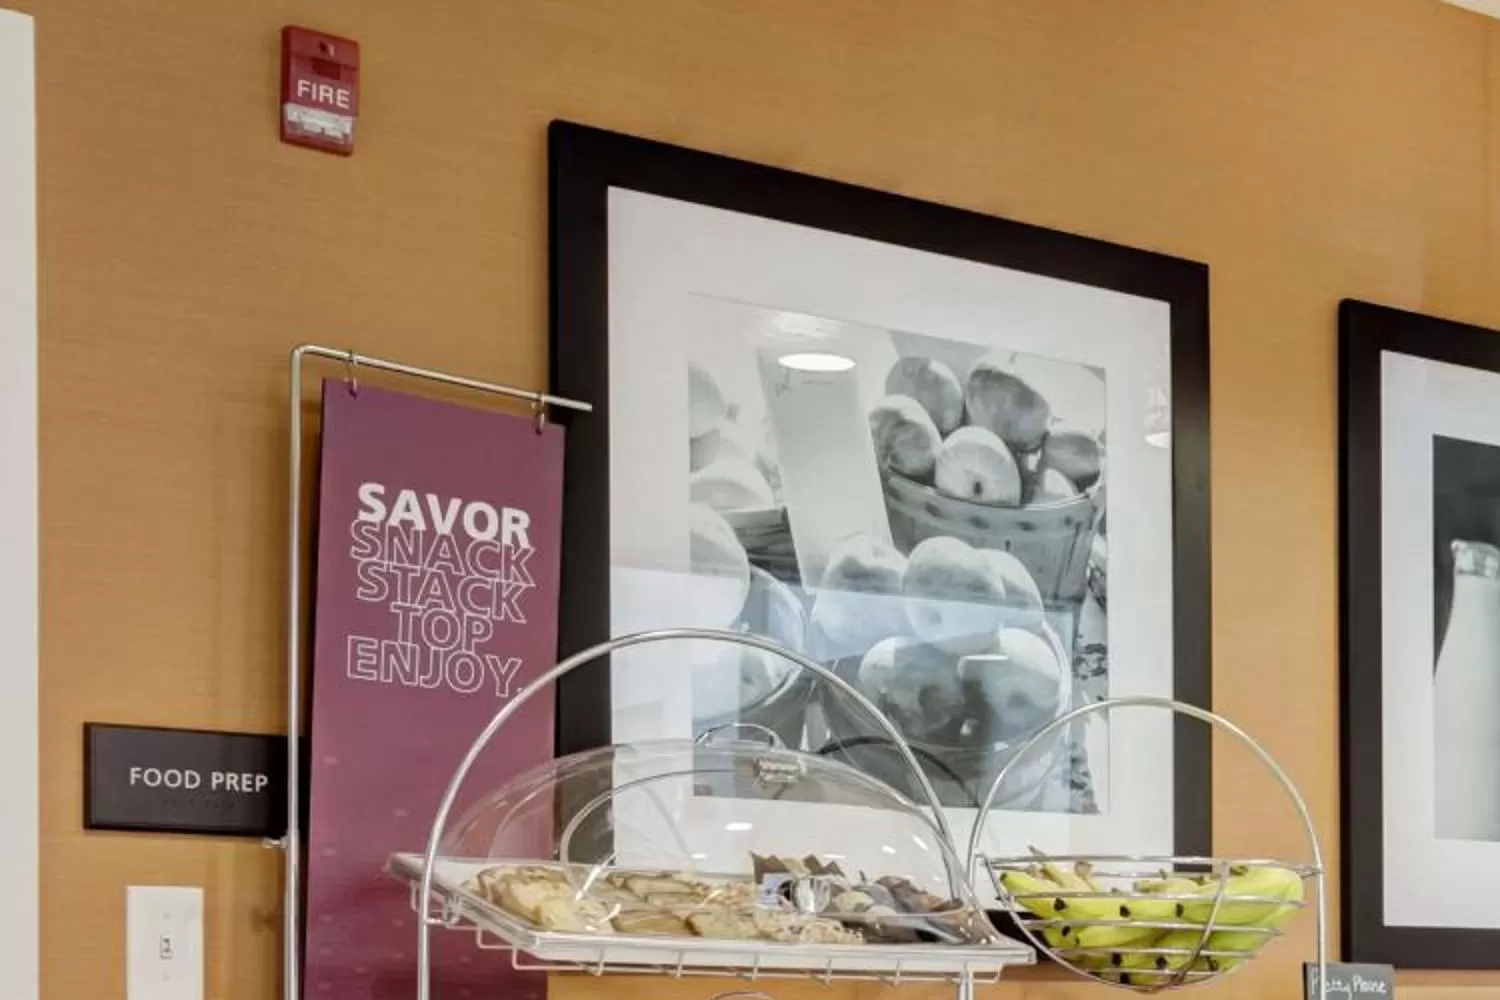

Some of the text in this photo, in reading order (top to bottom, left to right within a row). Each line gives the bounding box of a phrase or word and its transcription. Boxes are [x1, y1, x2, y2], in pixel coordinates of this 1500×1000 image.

[297, 79, 350, 110] FIRE
[357, 483, 530, 549] SAVOR
[350, 519, 536, 587] SNACK
[356, 559, 527, 624] STACK
[390, 602, 493, 653] TOP
[129, 766, 269, 793] FOOD PREP
